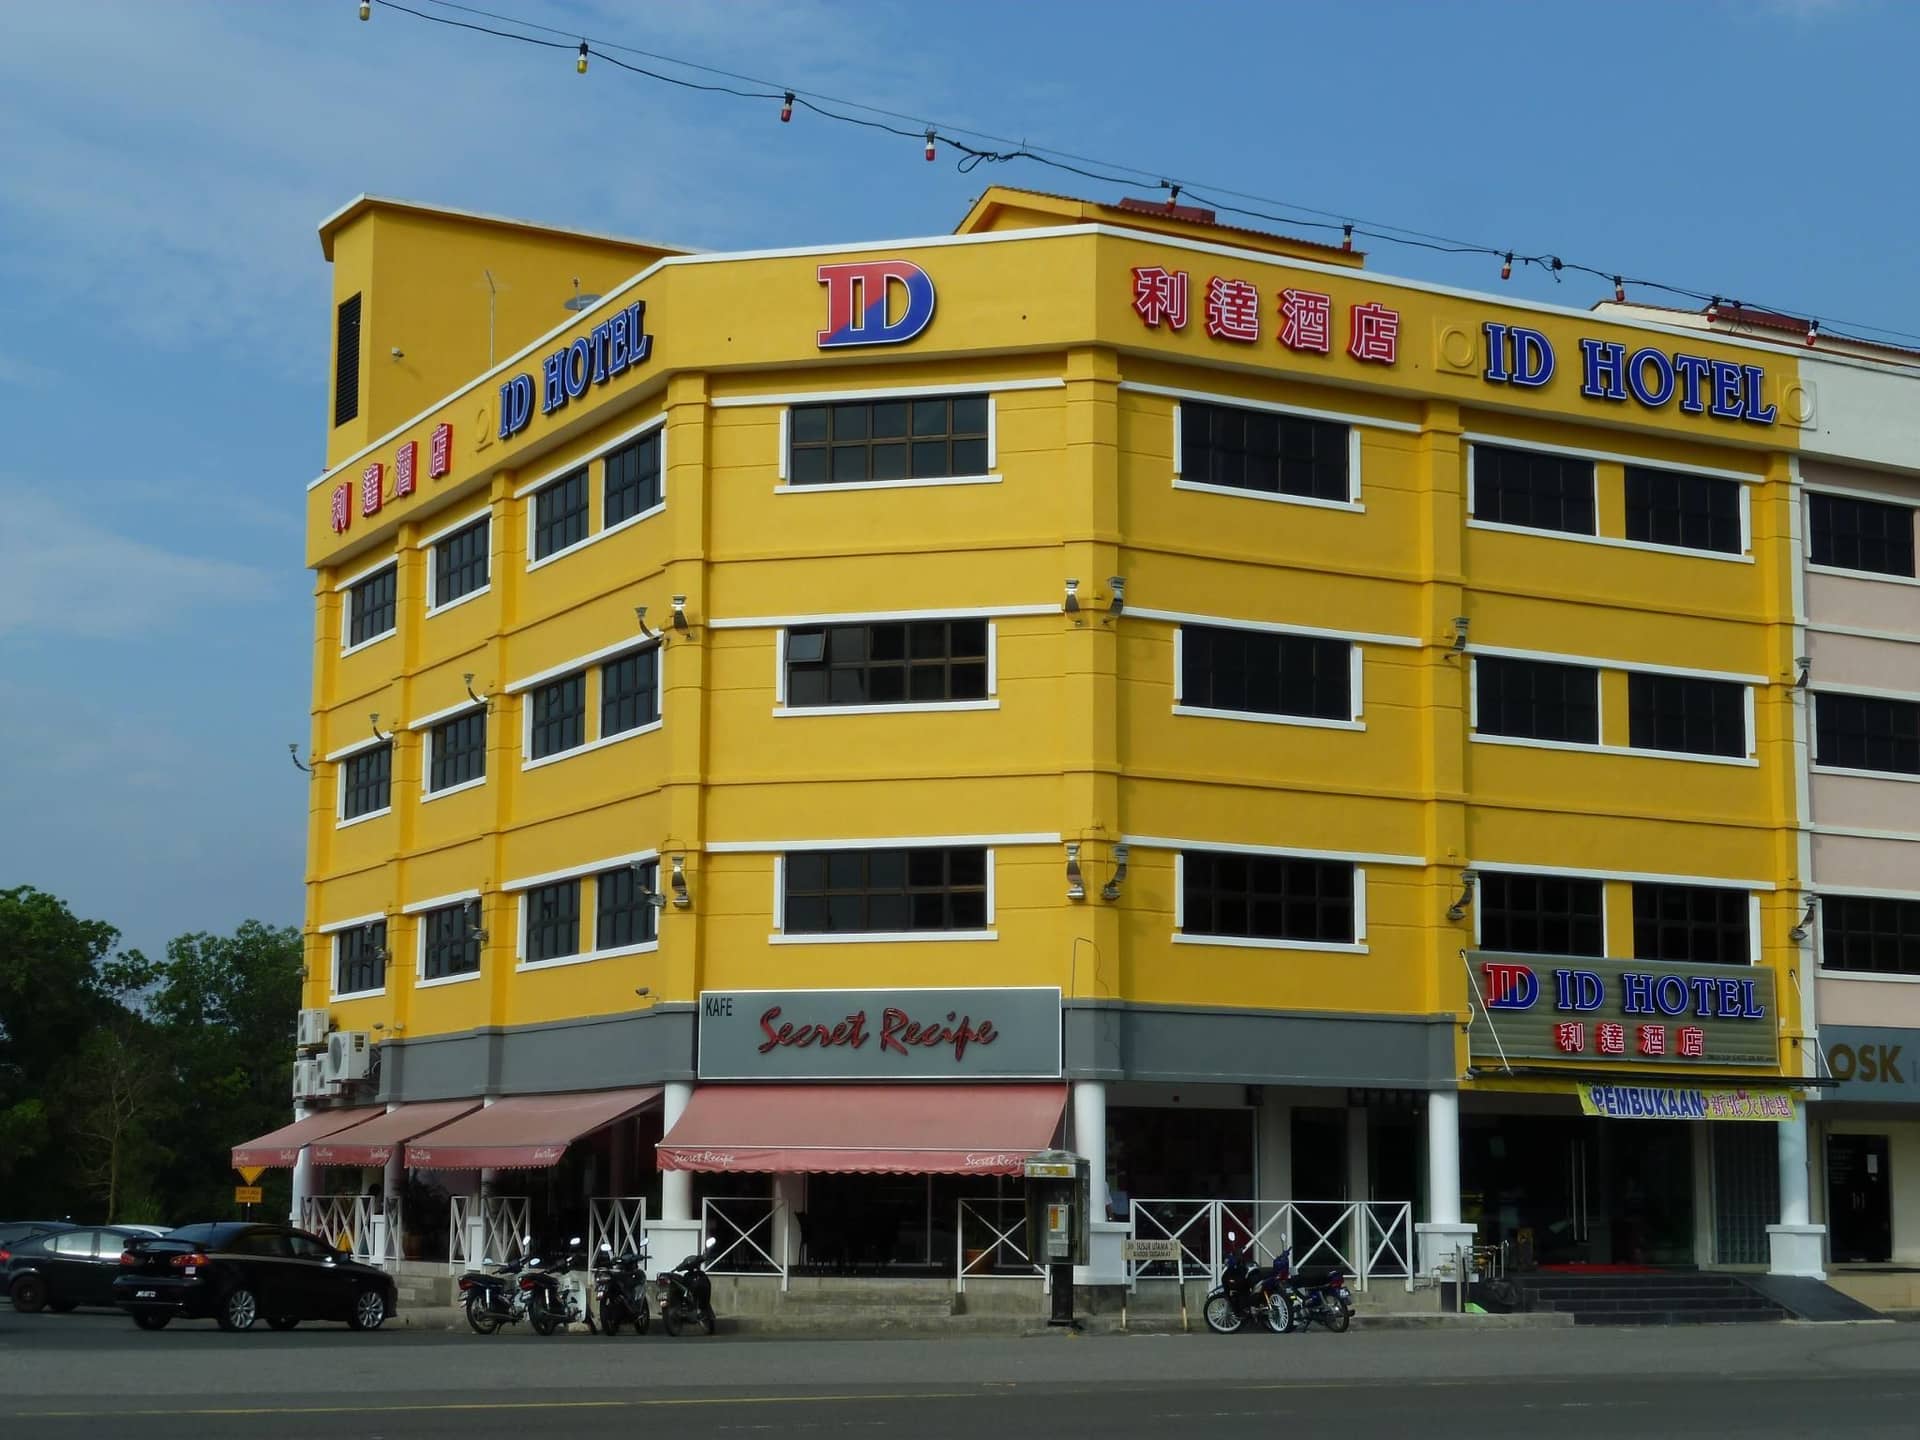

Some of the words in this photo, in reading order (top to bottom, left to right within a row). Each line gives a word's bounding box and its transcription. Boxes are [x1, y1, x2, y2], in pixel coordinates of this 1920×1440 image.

[816, 259, 936, 348] ID
[1132, 266, 1399, 364] 利達酒店
[498, 372, 535, 440] ID
[541, 300, 653, 414] HOTEL
[1482, 322, 1555, 386] ID
[1579, 338, 1777, 424] HOTEL
[331, 423, 453, 534] 利達酒店
[705, 997, 733, 1017] KAFE
[1482, 963, 1539, 1010] ID
[1555, 970, 1604, 1011] ID
[1622, 972, 1765, 1018] HOTEL
[758, 1006, 870, 1054] Secret
[880, 1007, 998, 1062] Recipe
[1555, 1022, 1705, 1057] 利達酒店
[1828, 1043, 1904, 1083] OSK
[1591, 1087, 1705, 1118] PEMBUKAAN
[674, 1150, 701, 1163] Secret
[703, 1151, 735, 1167] Recipe
[996, 1154, 1025, 1171] Recip
